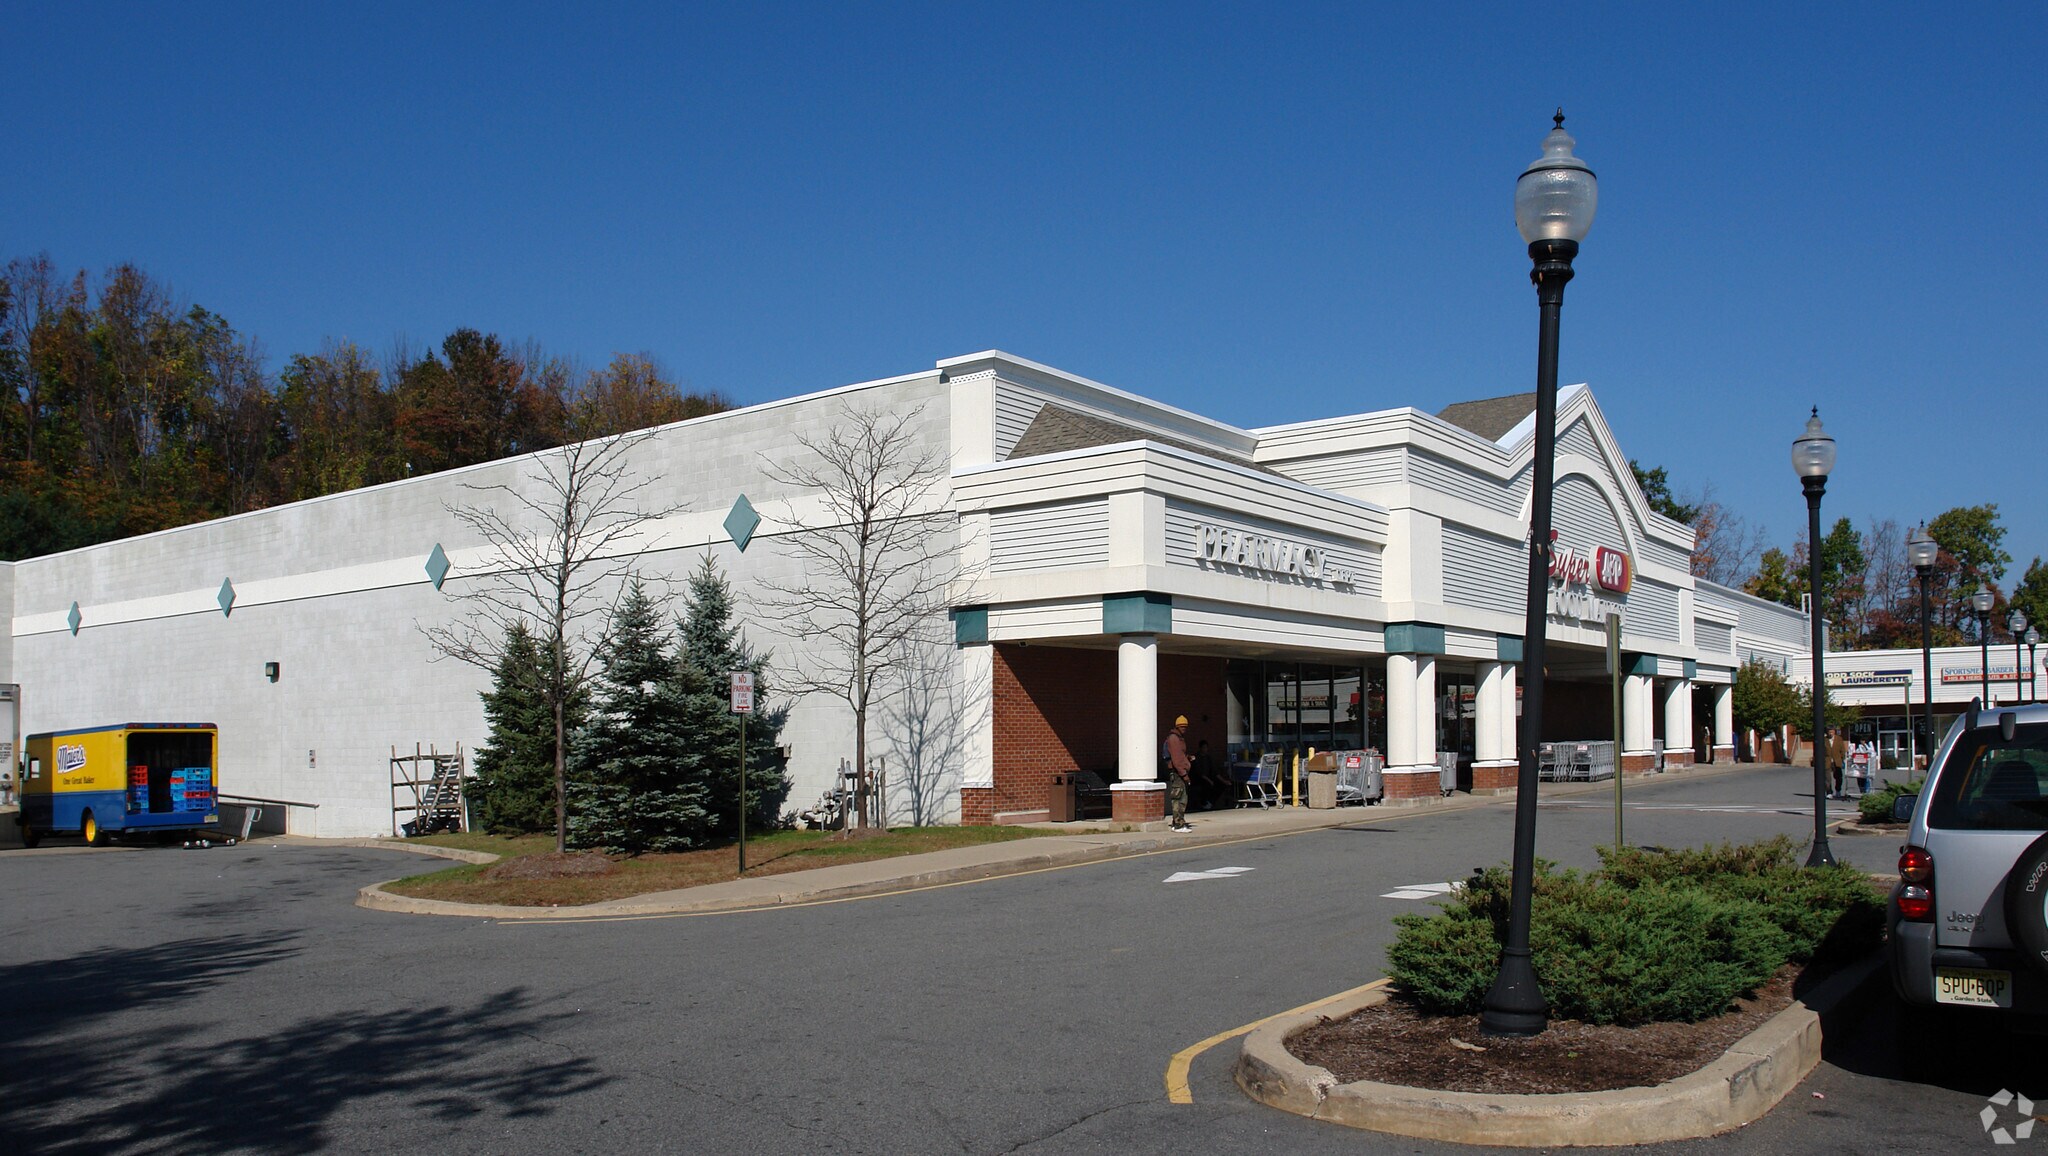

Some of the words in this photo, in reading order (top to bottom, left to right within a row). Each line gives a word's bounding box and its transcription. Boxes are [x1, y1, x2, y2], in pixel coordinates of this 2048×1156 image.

[1195, 524, 1326, 580] PHARMACY
[1855, 723, 1872, 733] OPEN
[1947, 911, 1985, 925] Jeep
